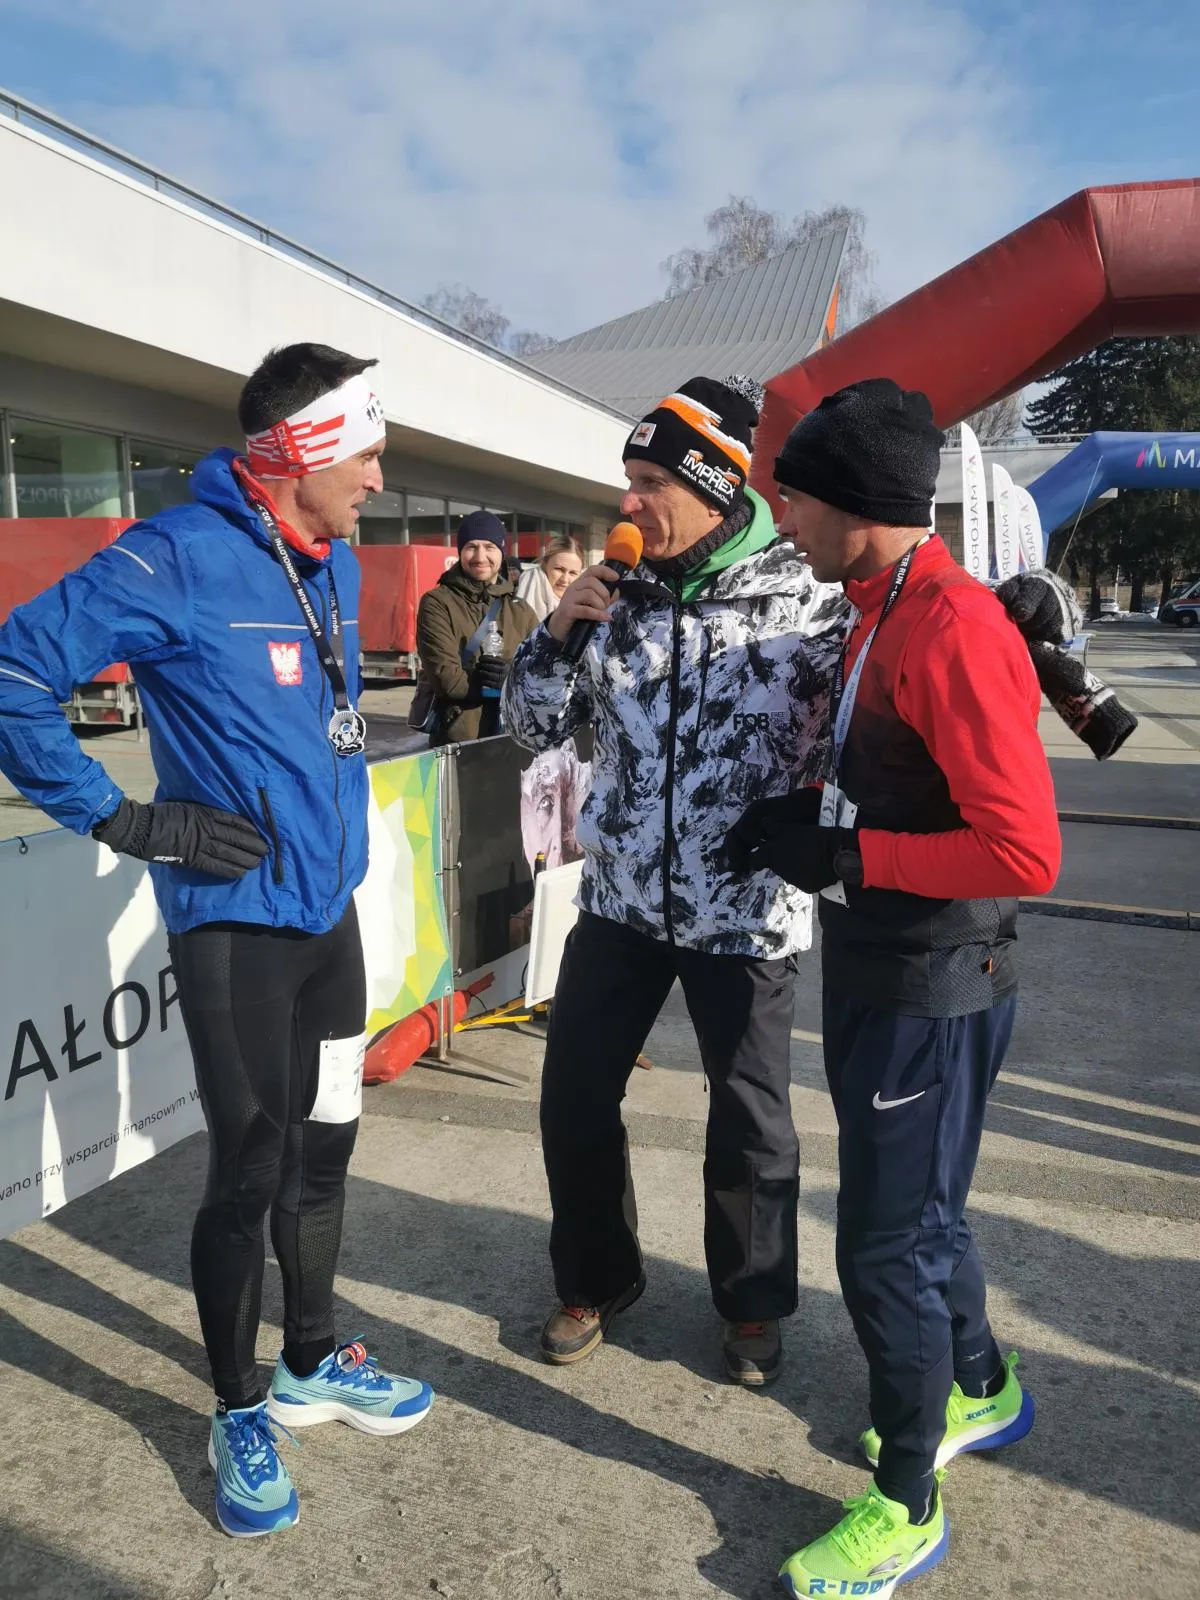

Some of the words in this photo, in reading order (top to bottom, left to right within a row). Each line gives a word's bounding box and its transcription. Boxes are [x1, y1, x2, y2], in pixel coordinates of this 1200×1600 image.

[1173, 447, 1200, 469] M
[682, 454, 736, 499] IMPREX
[895, 567, 907, 586] RUN
[296, 588, 308, 604] RUN
[303, 603, 320, 631] WINTER
[330, 608, 340, 636] Tarnów
[35, 1160, 63, 1187] przy
[65, 1129, 120, 1167] wsparciu
[123, 1095, 187, 1139] finansowym
